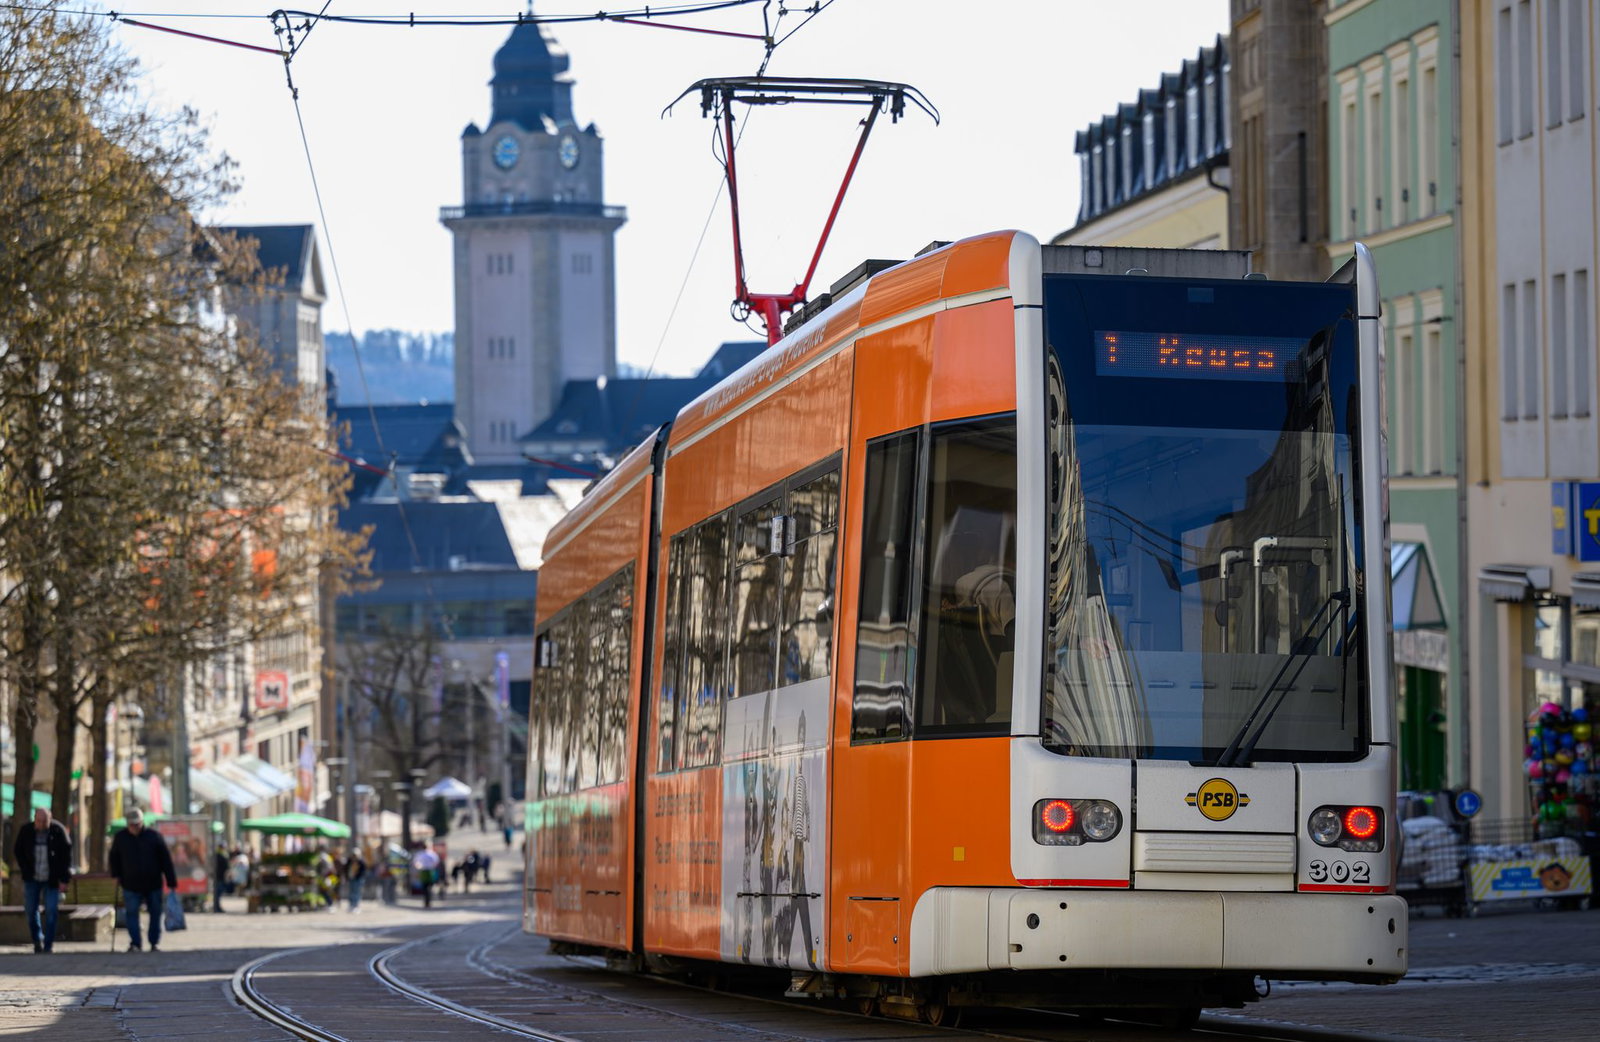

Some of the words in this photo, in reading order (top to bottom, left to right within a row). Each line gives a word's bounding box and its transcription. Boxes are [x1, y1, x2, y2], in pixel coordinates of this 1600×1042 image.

[1104, 336, 1117, 363] 1
[1201, 791, 1235, 808] PSB
[1308, 859, 1371, 884] 302
